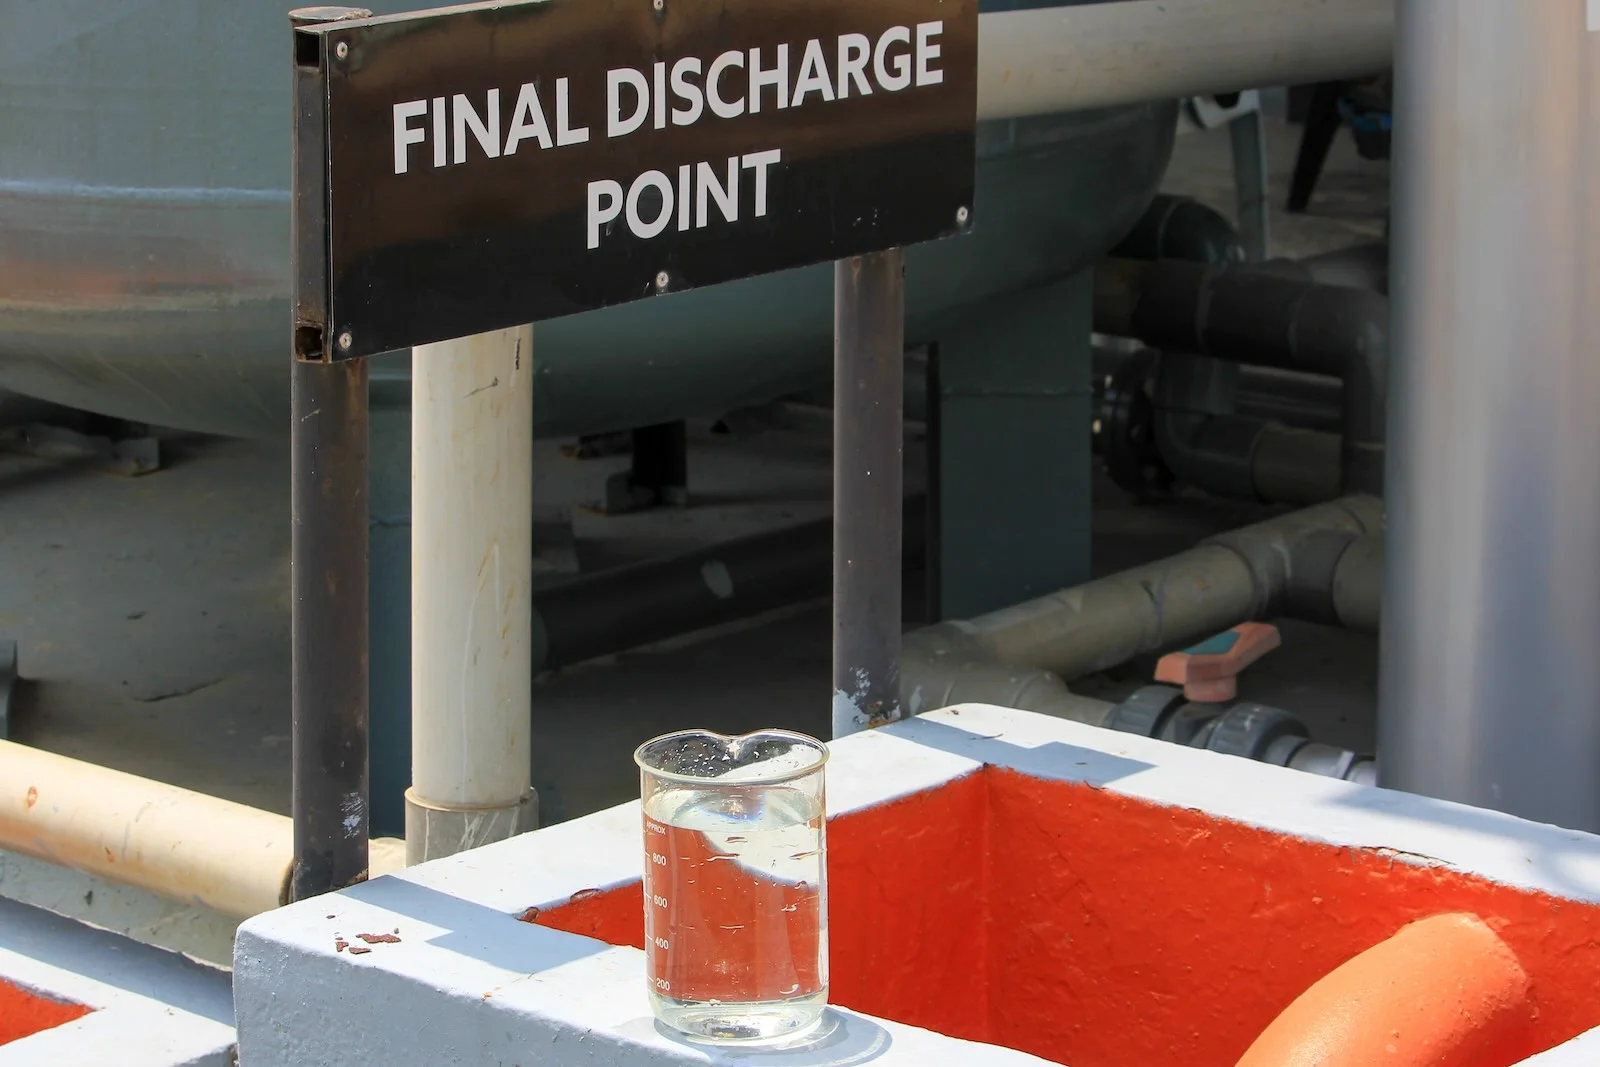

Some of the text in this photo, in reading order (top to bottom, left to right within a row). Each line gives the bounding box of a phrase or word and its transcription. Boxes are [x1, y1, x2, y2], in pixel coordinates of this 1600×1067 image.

[393, 20, 943, 175] FINAL DISCHARGE
[587, 148, 781, 250] POINT
[652, 852, 667, 867] 800
[654, 894, 668, 909] 600
[655, 936, 669, 950] 400
[656, 977, 671, 991] 200
